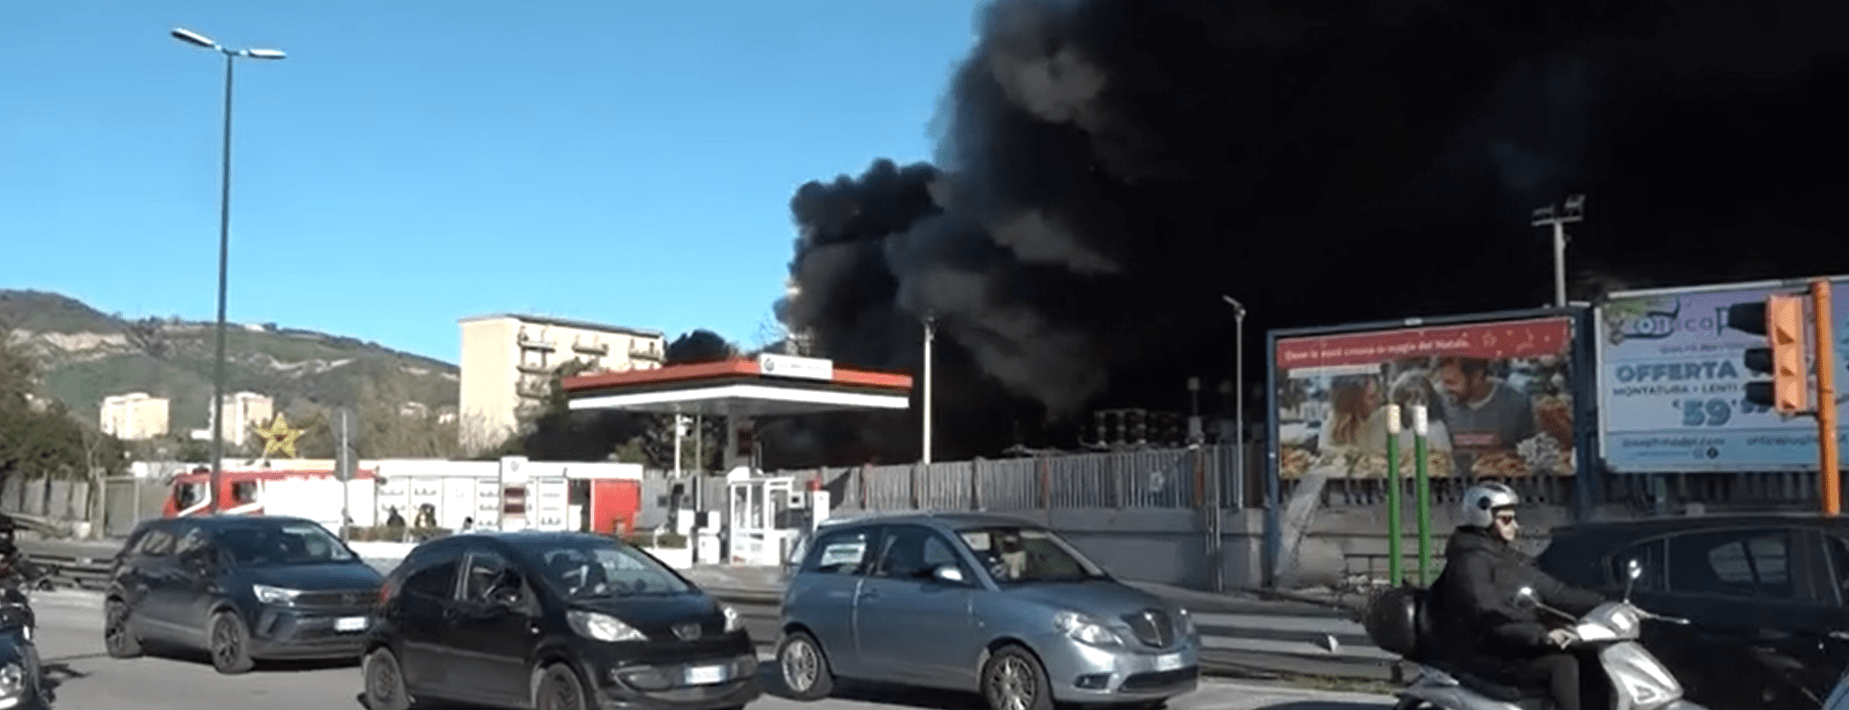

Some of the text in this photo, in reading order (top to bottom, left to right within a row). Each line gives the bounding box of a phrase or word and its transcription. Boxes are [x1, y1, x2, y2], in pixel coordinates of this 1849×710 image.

[1616, 359, 1739, 382] OFFERTA
[1613, 385, 1688, 397] MONTATURA
[1702, 382, 1738, 394] LENTI
